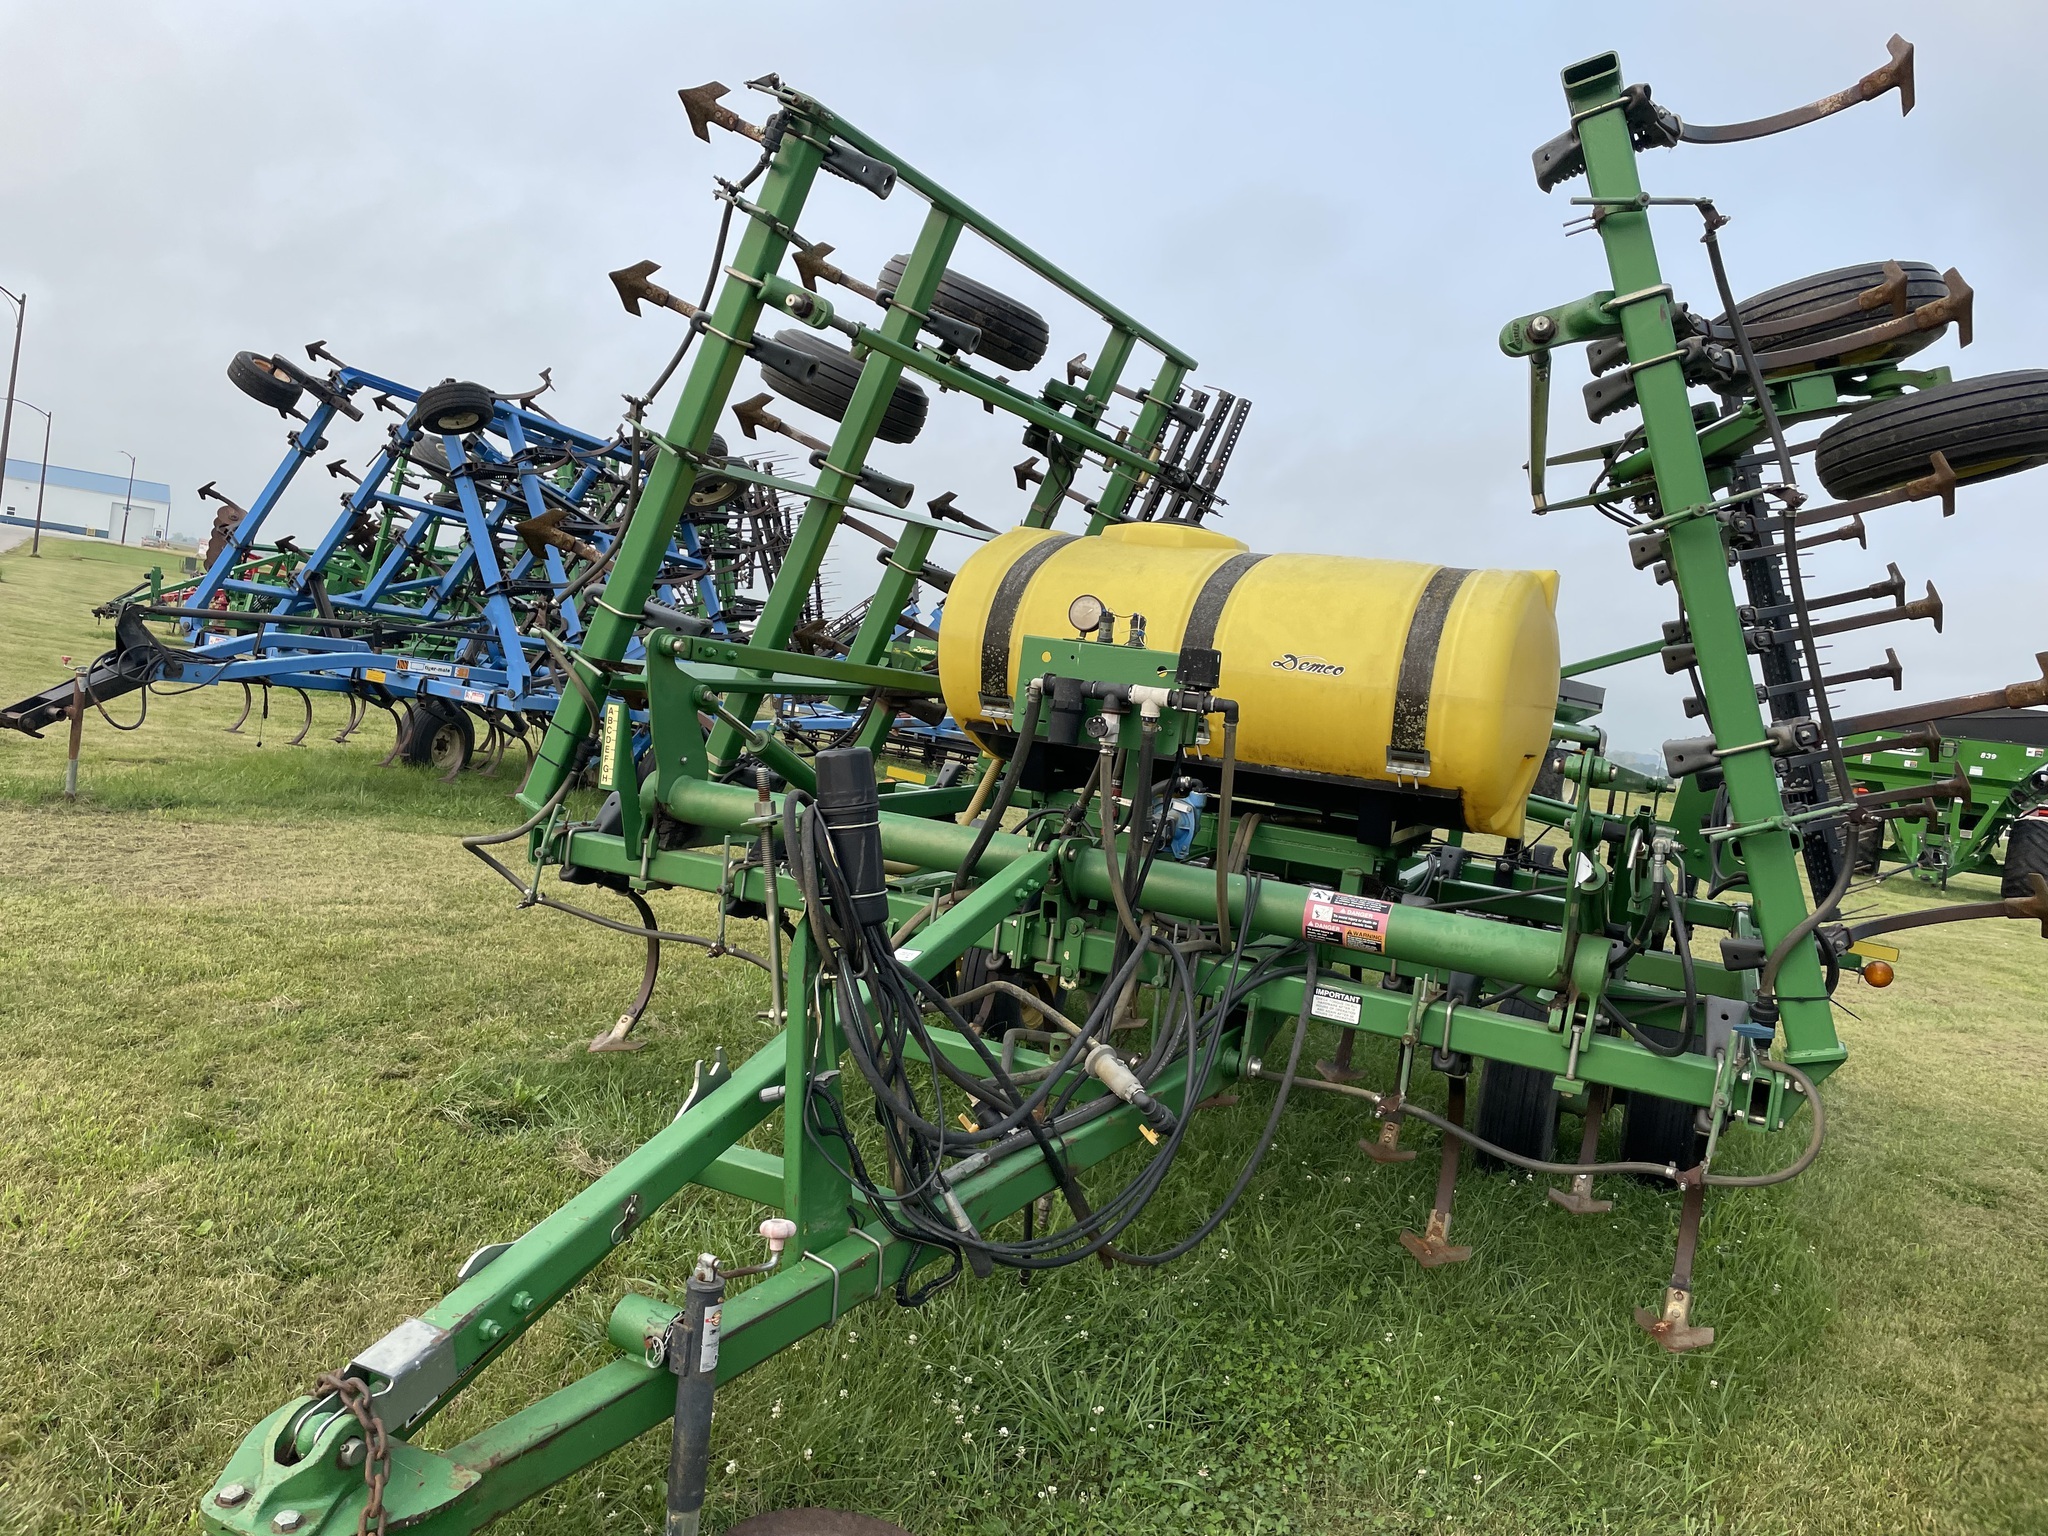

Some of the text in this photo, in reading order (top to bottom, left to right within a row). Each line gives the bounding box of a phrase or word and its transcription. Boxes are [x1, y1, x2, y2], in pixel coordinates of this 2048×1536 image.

[1272, 653, 1345, 676] Demco
[1980, 752, 1997, 760] 839
[1347, 910, 1374, 918] DANGER
[1314, 923, 1341, 931] DANGER
[1354, 931, 1382, 940] WARNING
[1315, 988, 1361, 1003] IMPORTANT
